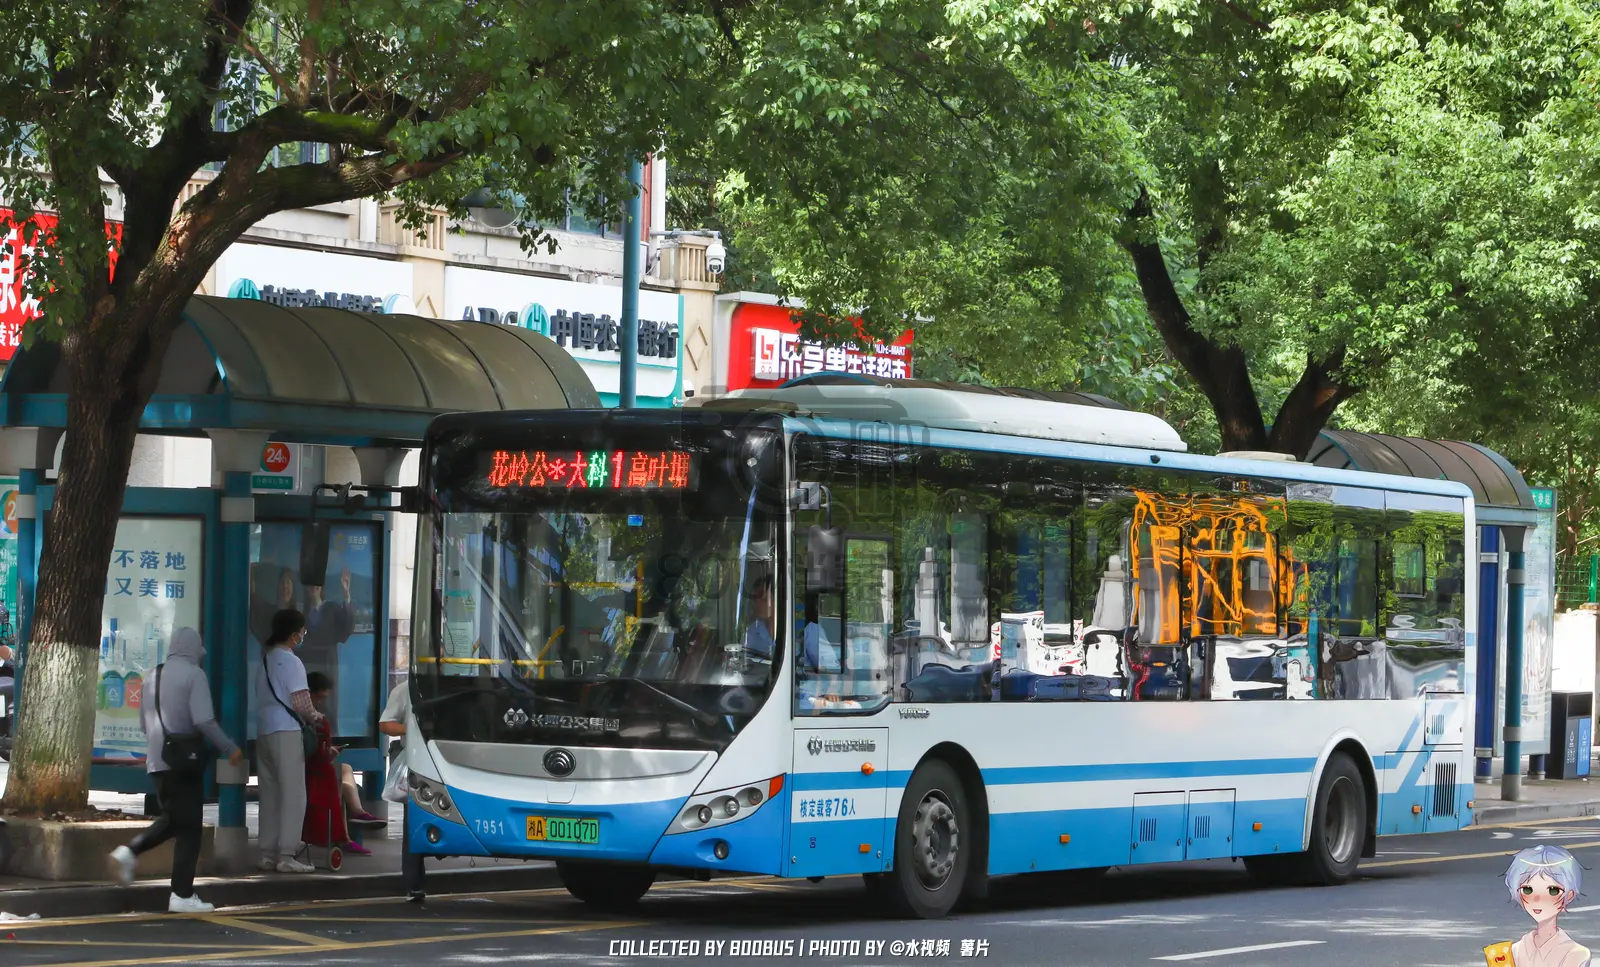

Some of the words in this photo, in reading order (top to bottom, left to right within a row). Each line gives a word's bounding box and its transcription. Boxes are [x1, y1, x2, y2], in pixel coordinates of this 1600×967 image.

[550, 308, 680, 359] 中国农银行
[113, 549, 187, 571] 不落地
[104, 577, 186, 599] 又美丽
[799, 796, 857, 818] 核定载客76人
[475, 818, 504, 836] 7951
